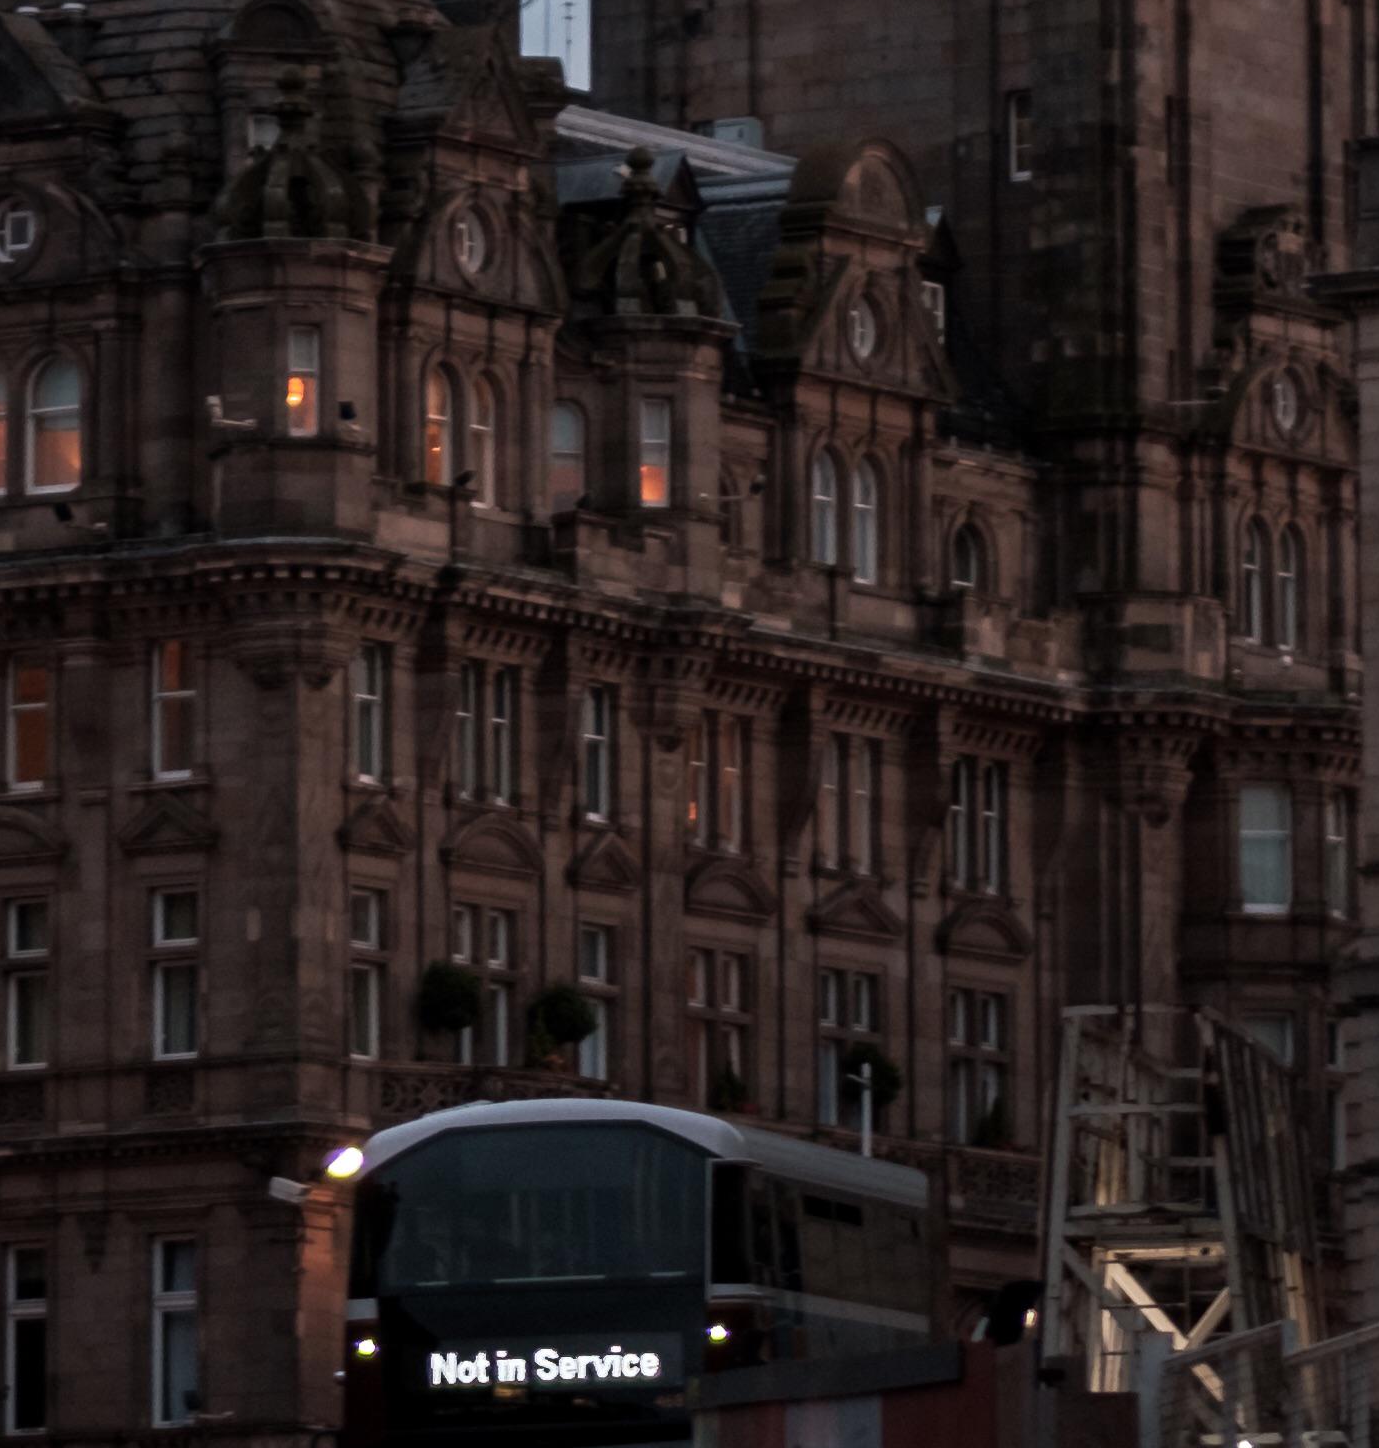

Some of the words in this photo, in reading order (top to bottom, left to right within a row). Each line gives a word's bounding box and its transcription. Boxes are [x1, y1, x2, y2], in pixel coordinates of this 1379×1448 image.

[429, 1352, 491, 1385] Not
[495, 1350, 527, 1382] in
[533, 1345, 660, 1381] Service
